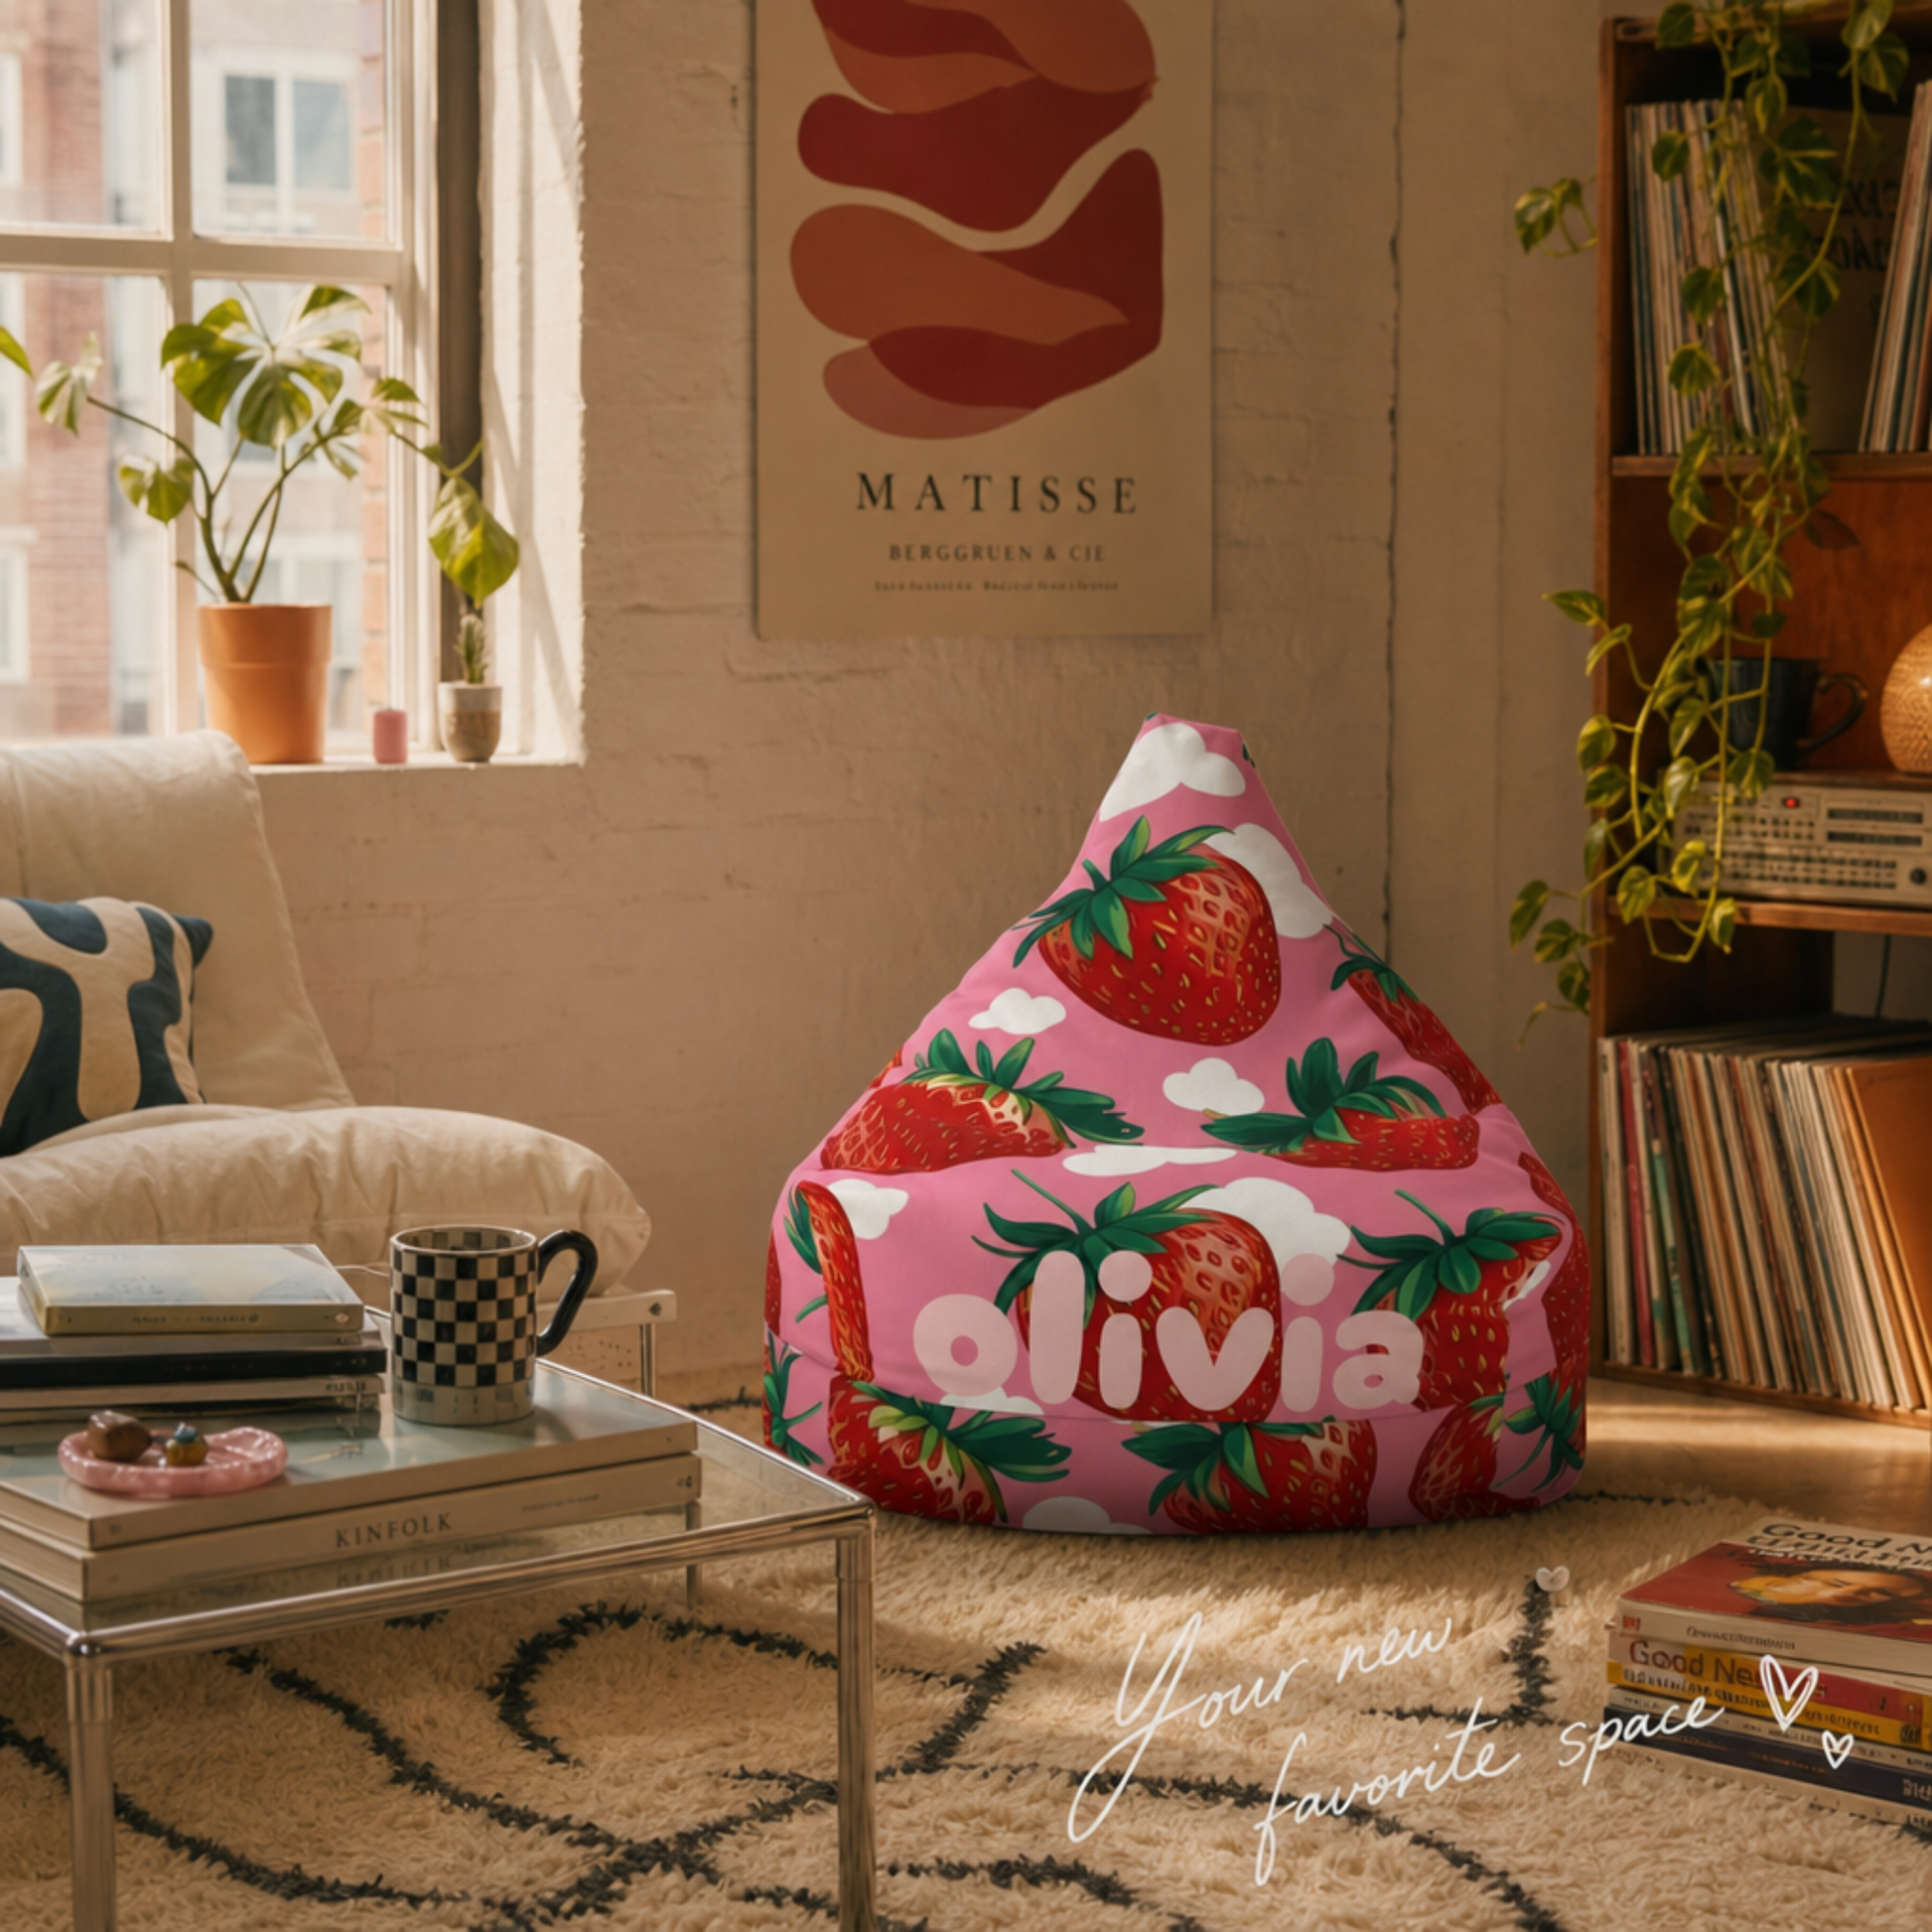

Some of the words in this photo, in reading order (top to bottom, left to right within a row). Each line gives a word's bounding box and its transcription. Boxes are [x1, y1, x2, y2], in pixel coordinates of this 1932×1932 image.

[855, 472, 1137, 513] MATISSE
[889, 544, 1033, 562] BERGGRUEN
[1043, 545, 1057, 562] &
[1068, 545, 1106, 562] CIE
[912, 1249, 1425, 1412] olivia
[336, 1512, 453, 1549] KINFOLK
[1762, 1523, 1892, 1549] Good
[1629, 1639, 1705, 1678] Good
